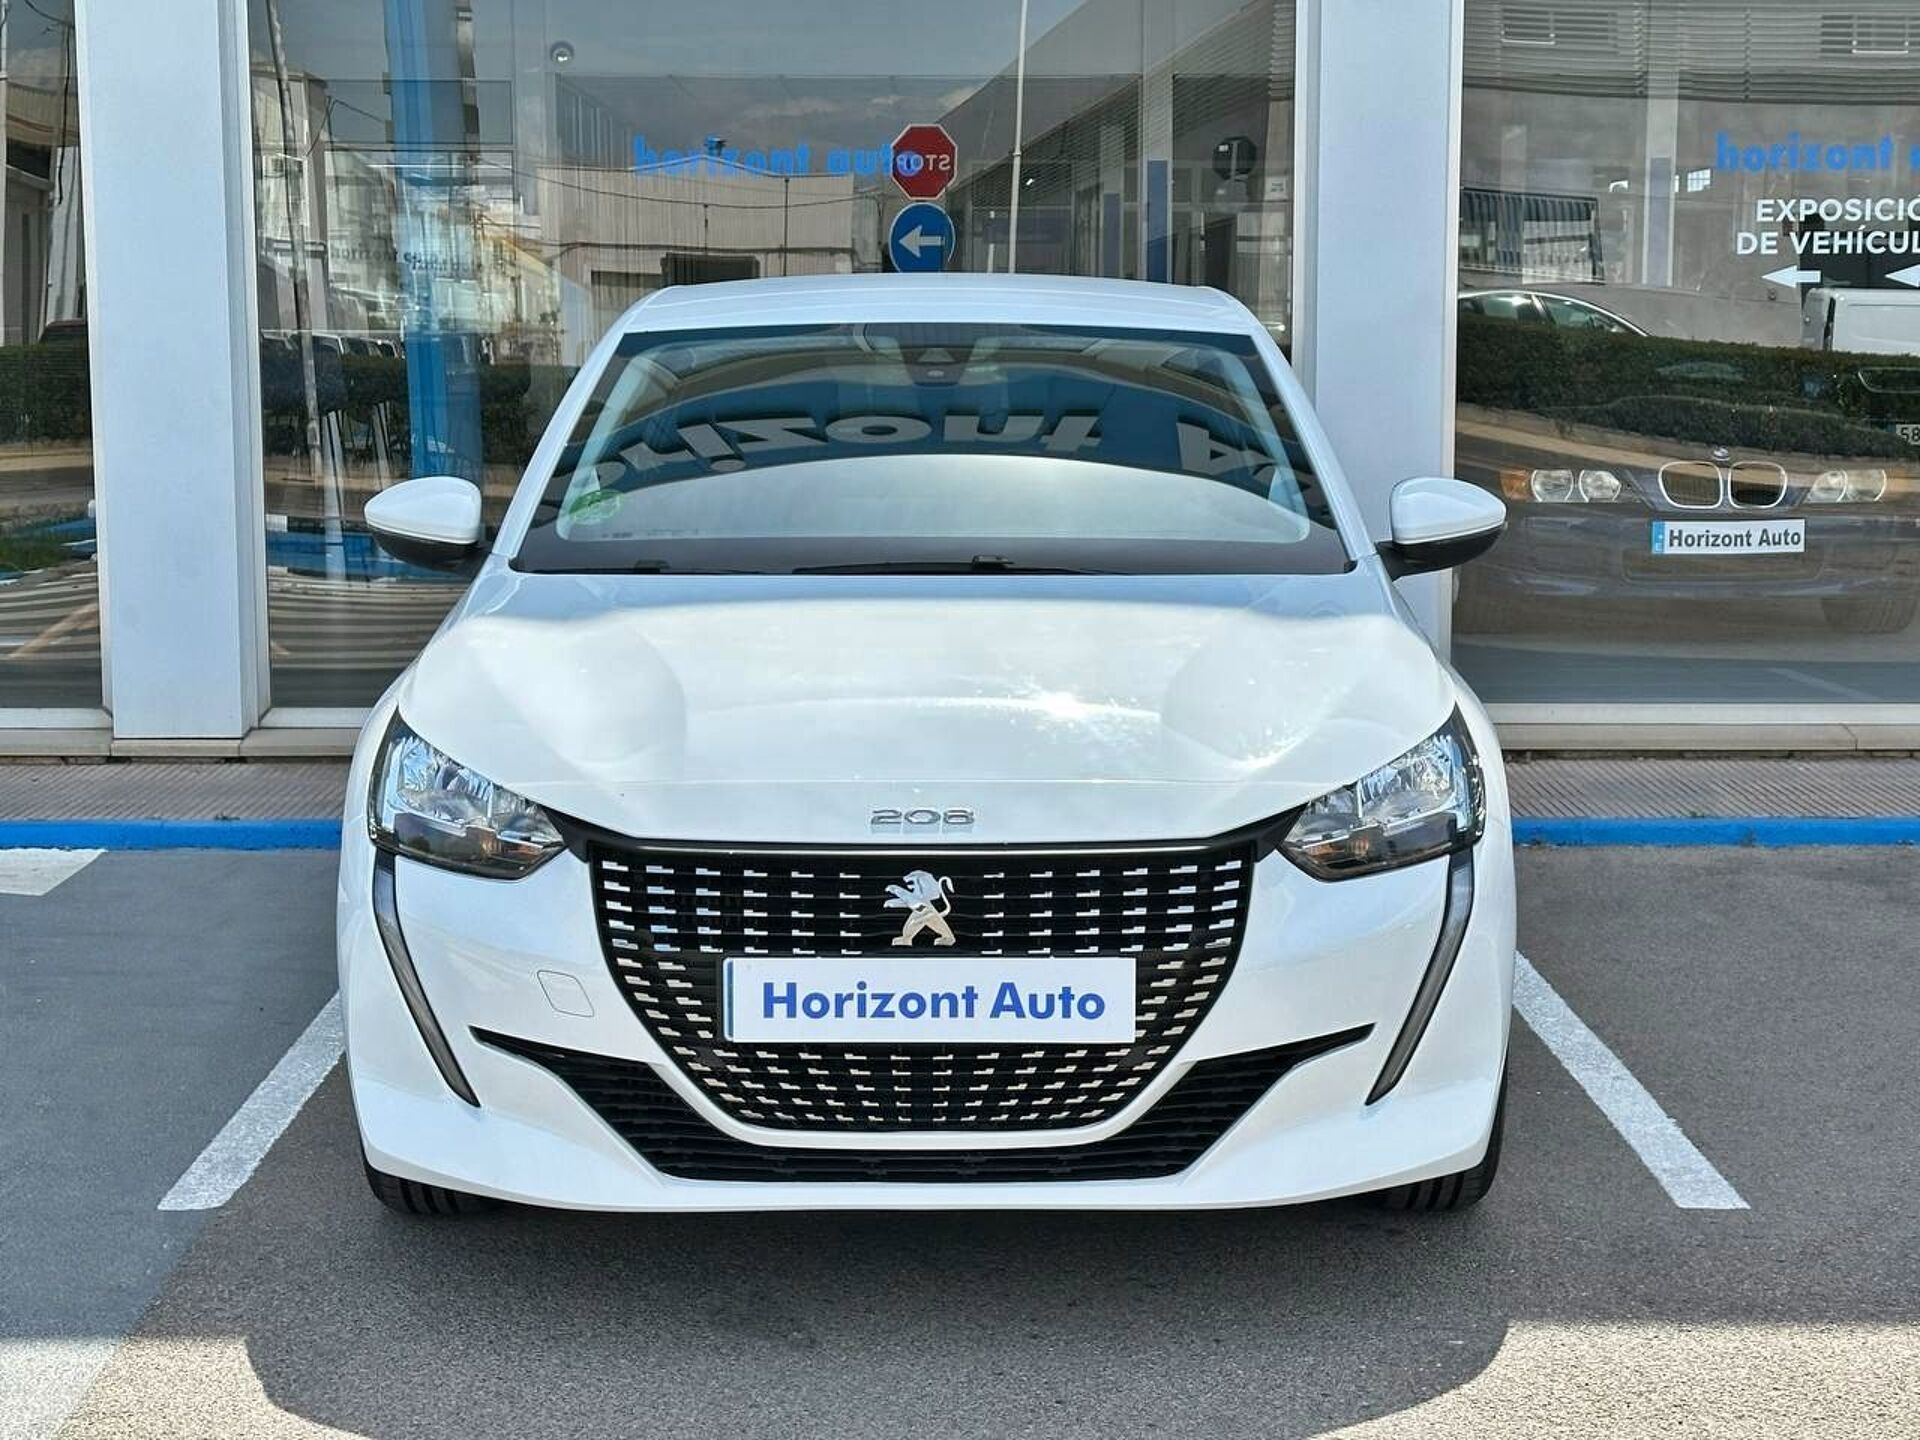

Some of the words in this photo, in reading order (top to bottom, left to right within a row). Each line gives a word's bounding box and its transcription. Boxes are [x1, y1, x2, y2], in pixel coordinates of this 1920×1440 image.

[826, 142, 920, 177] auto
[1716, 131, 1893, 171] horizont
[1737, 232, 1779, 255] DE
[1669, 529, 1752, 547] Horizont
[1758, 528, 1801, 546] Auto
[871, 808, 975, 826] 208
[763, 981, 978, 1019] Horizont
[989, 981, 1105, 1020] Auto
